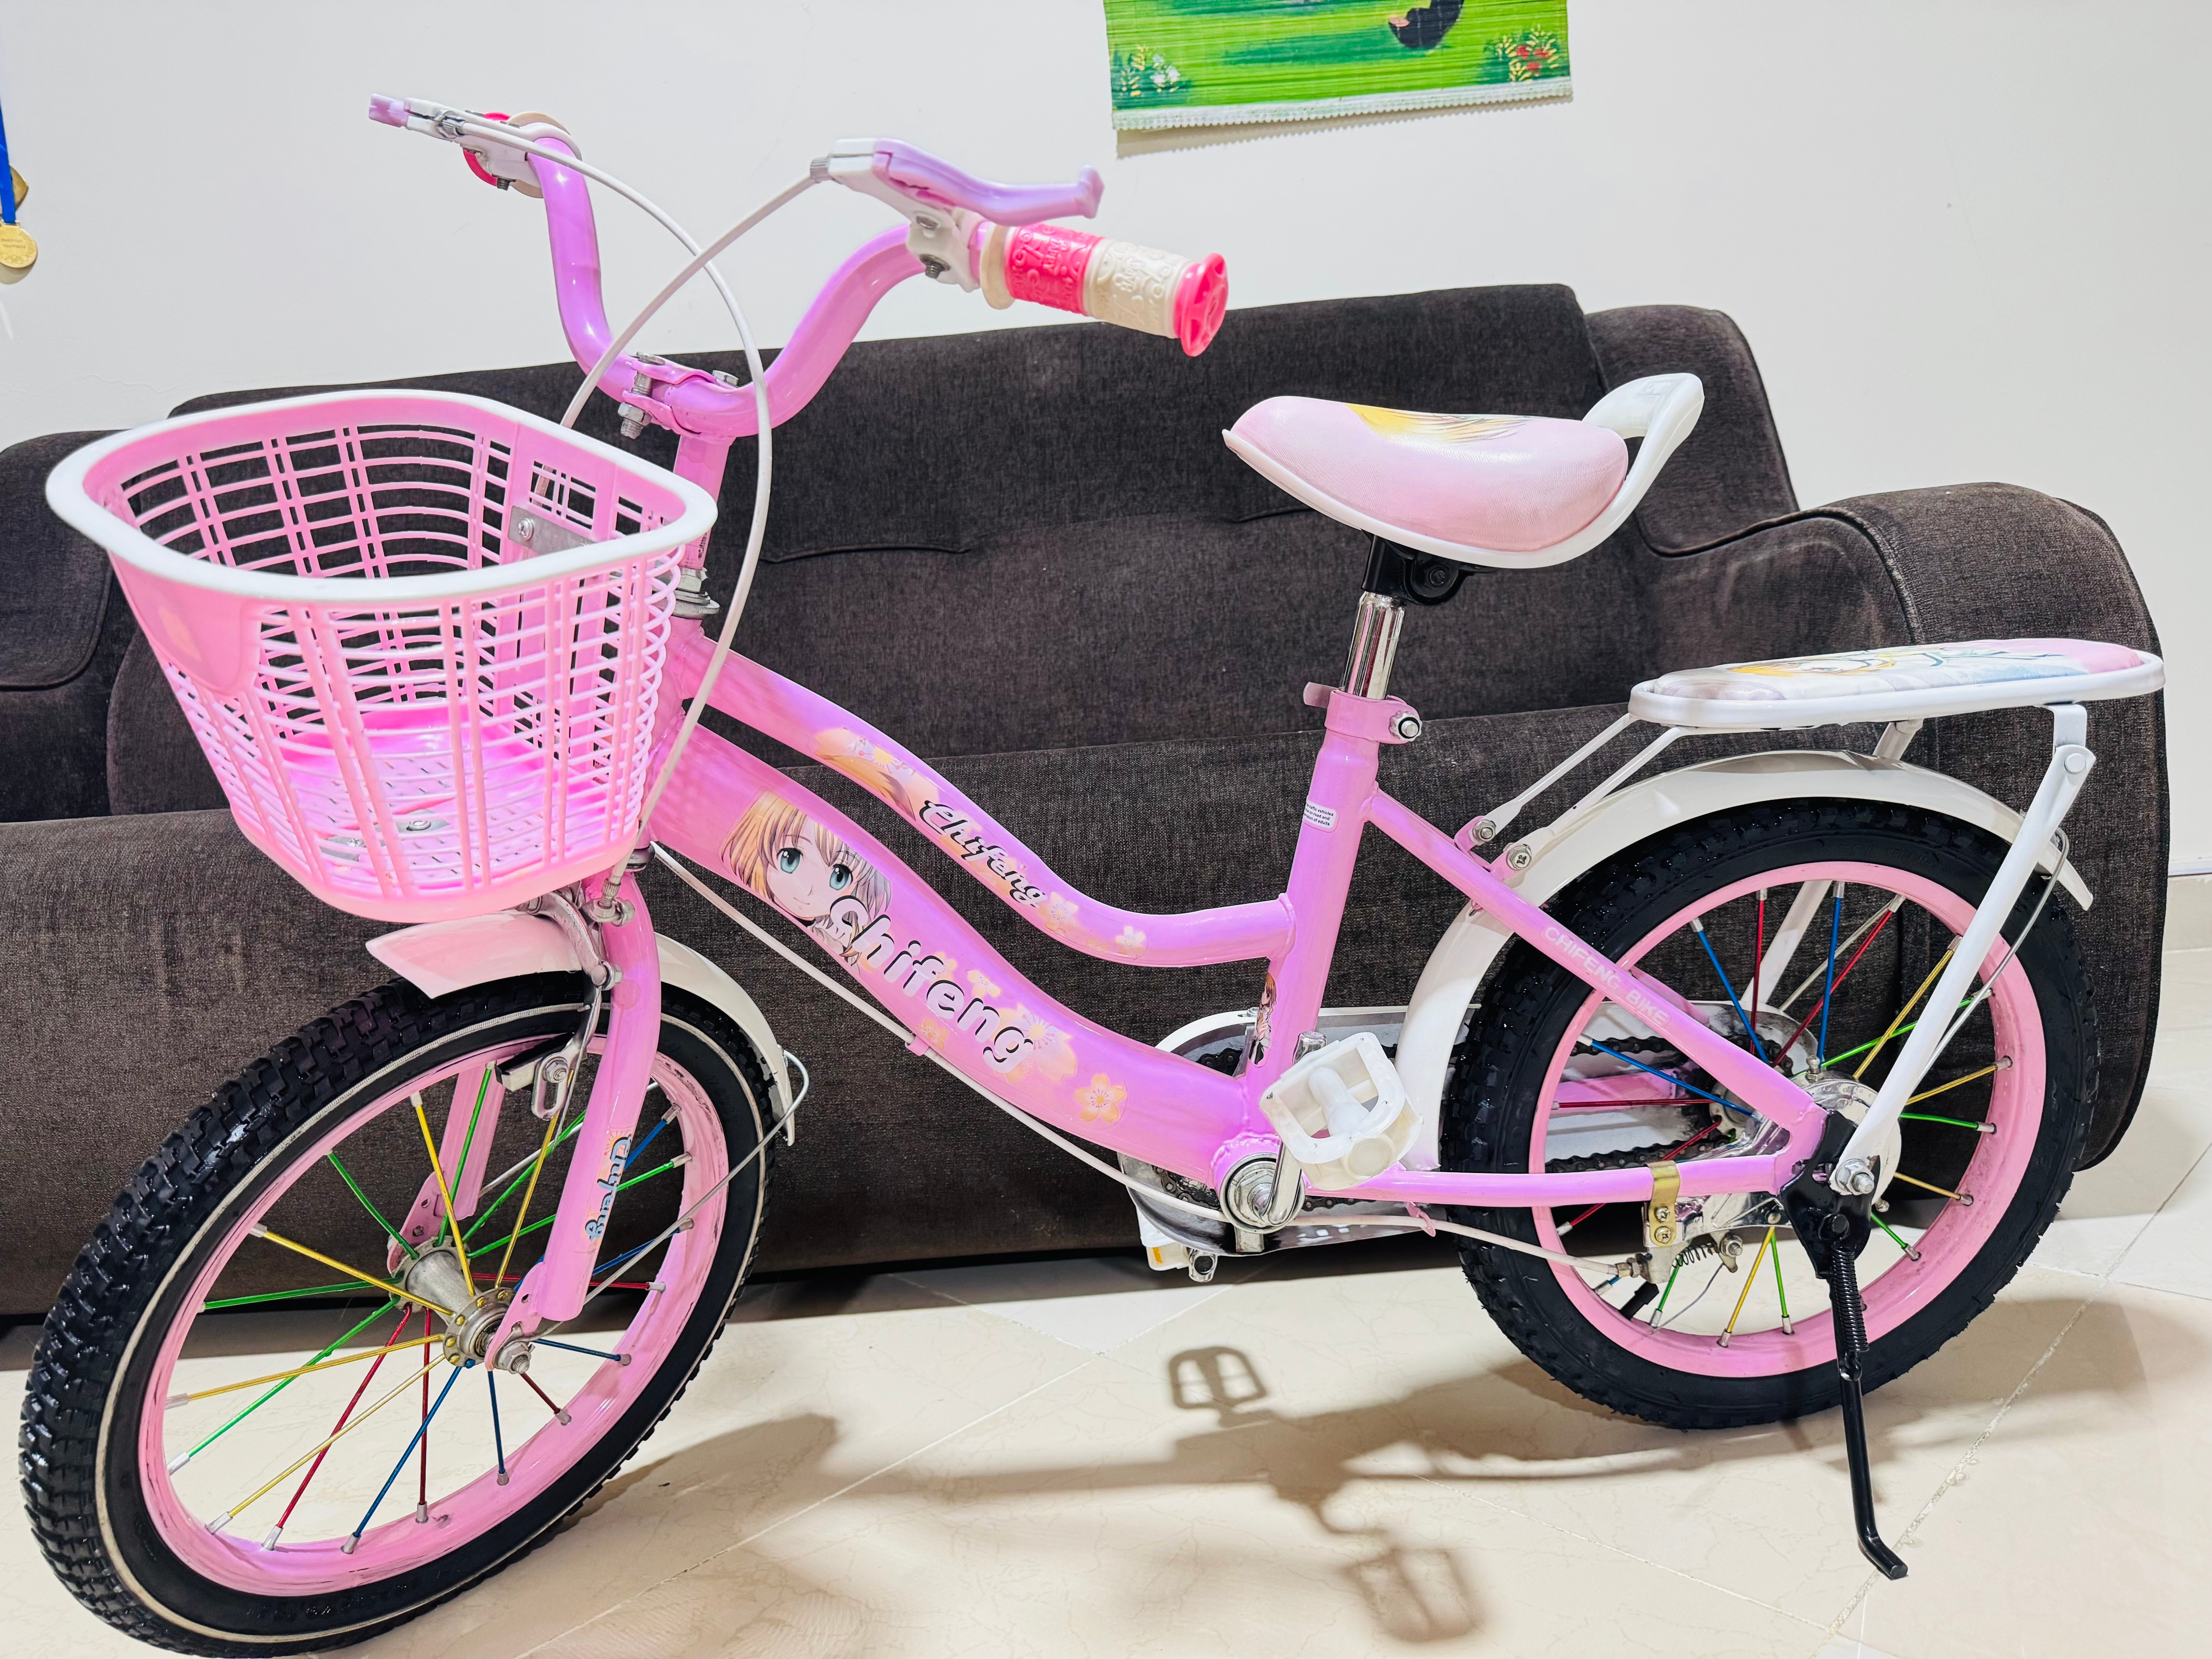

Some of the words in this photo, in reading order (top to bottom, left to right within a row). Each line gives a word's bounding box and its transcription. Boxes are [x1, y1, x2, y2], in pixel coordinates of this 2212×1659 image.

[919, 800, 1047, 908] Chifeng
[830, 895, 1034, 1073] Chifeng
[1544, 927, 1620, 990] CHIFENG
[1626, 990, 1669, 1025] BIKE
